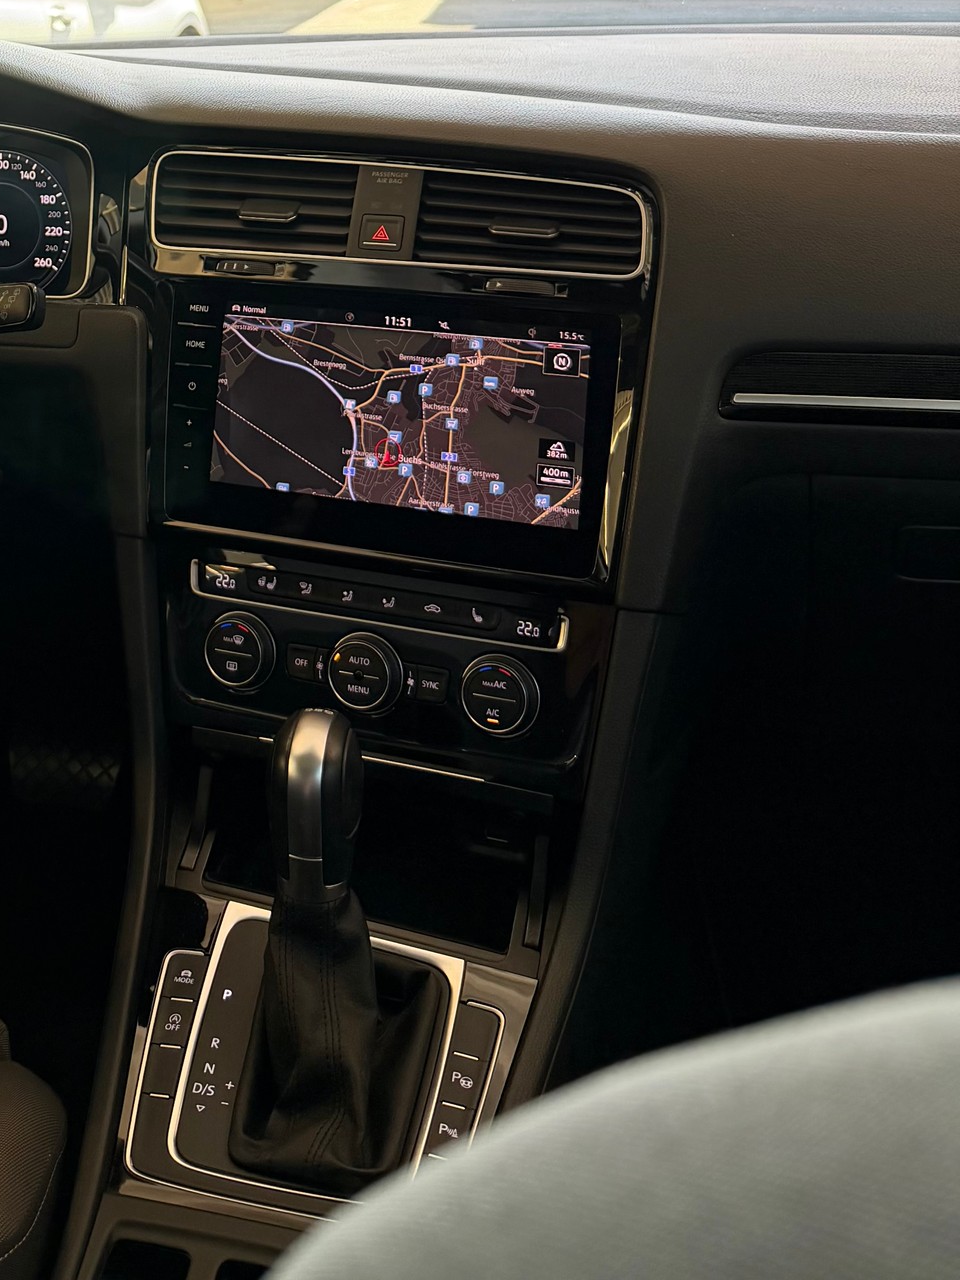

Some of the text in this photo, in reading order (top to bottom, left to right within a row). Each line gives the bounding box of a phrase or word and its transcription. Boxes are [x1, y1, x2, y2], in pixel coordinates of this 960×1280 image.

[11, 162, 22, 170] 120
[20, 170, 36, 180] 140
[40, 194, 56, 204] 180
[45, 226, 63, 236] 220
[45, 244, 58, 252] 240
[34, 257, 52, 268] 260
[189, 304, 209, 312] MENU
[242, 305, 267, 315] Normal
[384, 315, 412, 328] 11:51
[185, 340, 206, 349] HOME
[313, 358, 347, 371] Brestenegg
[557, 357, 567, 367] N
[511, 386, 535, 397] Auweg
[397, 454, 423, 465] Buchs
[445, 452, 453, 461] 23
[215, 573, 236, 589] 22.0
[516, 620, 540, 637] 22.0
[294, 658, 309, 667] OFF
[348, 655, 371, 666] AUTO
[347, 684, 370, 695] MENU
[421, 680, 440, 690] SYNC
[486, 708, 500, 717] A/C
[173, 976, 194, 985] MODE
[222, 989, 233, 1000] P
[164, 1023, 181, 1032] OFF
[210, 1037, 220, 1049] R
[203, 1062, 215, 1075] N
[451, 1071, 462, 1083] P
[192, 1081, 216, 1096] D/S
